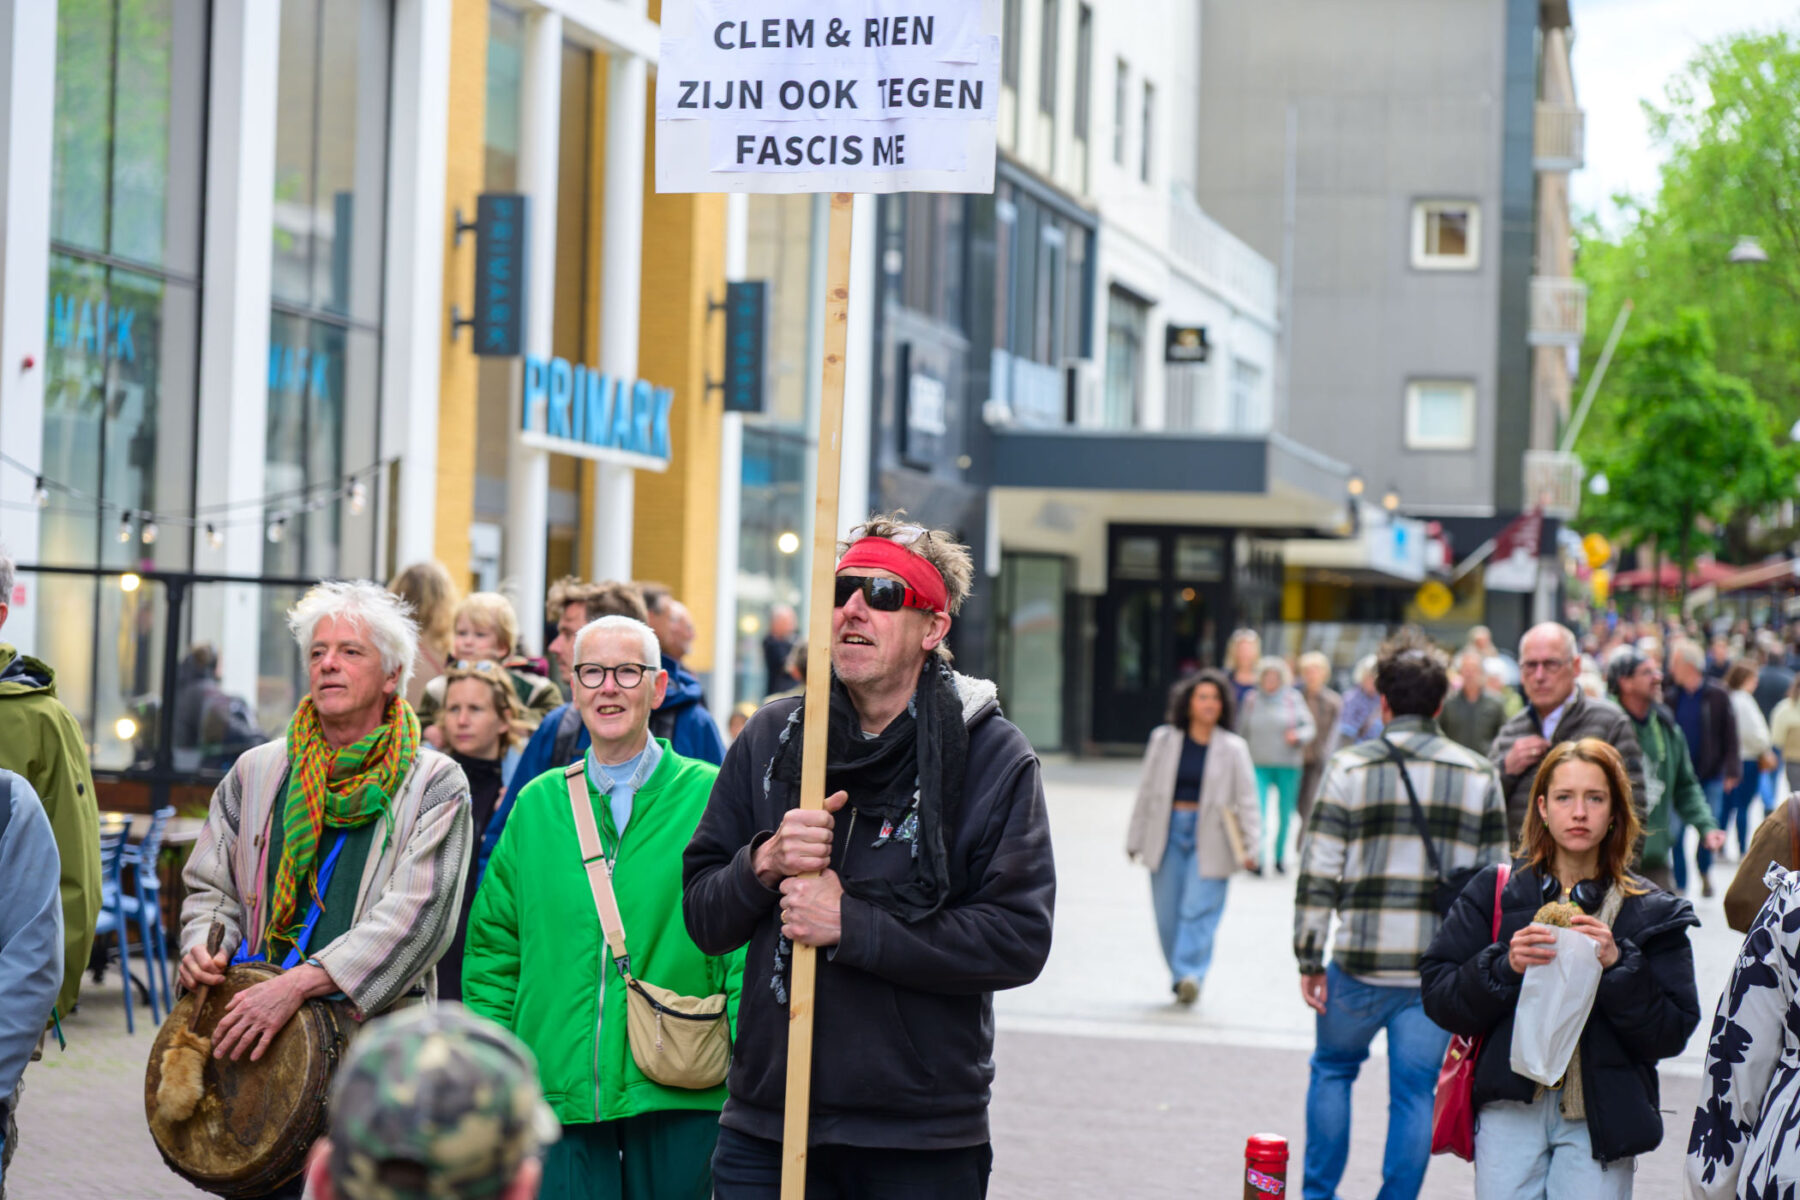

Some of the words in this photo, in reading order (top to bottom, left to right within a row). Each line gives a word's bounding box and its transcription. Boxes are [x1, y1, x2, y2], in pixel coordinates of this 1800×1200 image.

[714, 18, 814, 50] CLEM
[825, 17, 850, 48] &
[864, 15, 934, 48] RIEN
[677, 80, 763, 110] ZIJN
[779, 79, 857, 111] OOK
[877, 77, 983, 110] TEGEN
[523, 353, 673, 459] PRIMARK
